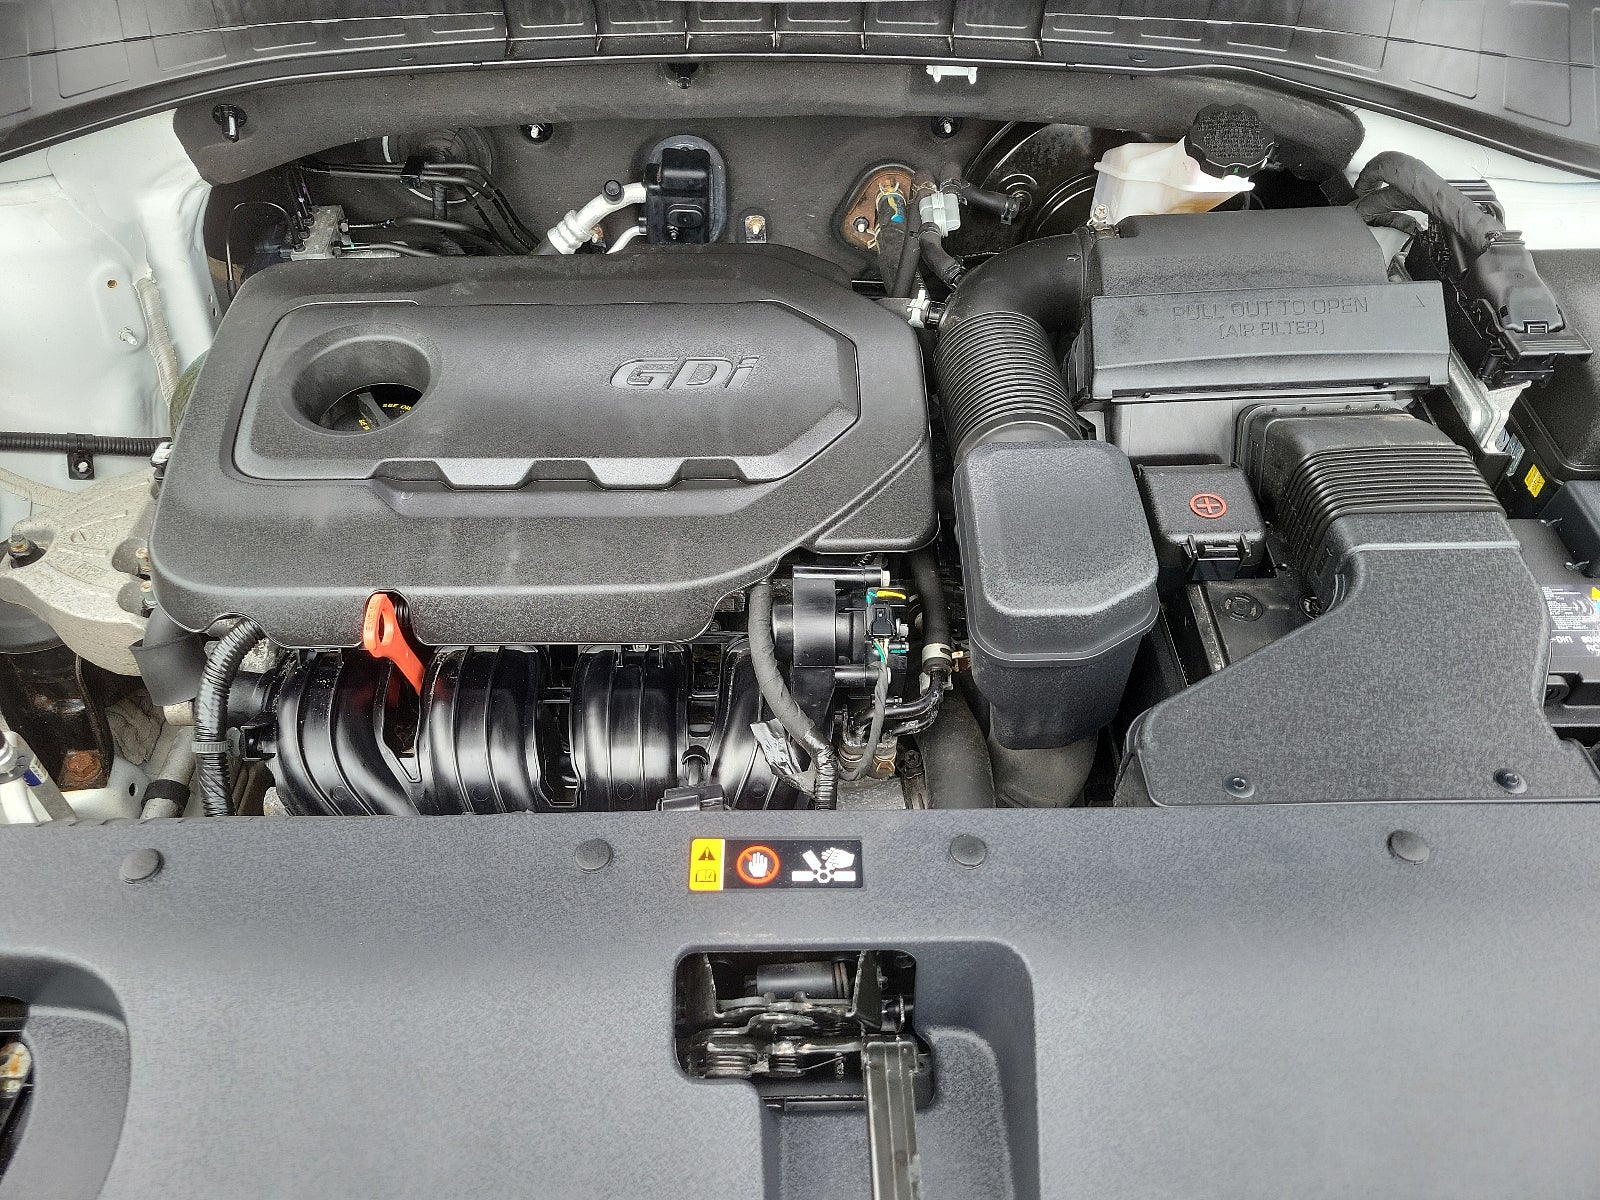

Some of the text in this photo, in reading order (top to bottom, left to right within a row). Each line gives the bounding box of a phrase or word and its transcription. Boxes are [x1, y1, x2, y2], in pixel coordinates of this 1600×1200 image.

[1172, 297, 1368, 321] PULL OUT TO OPEN
[610, 355, 760, 390] GDi
